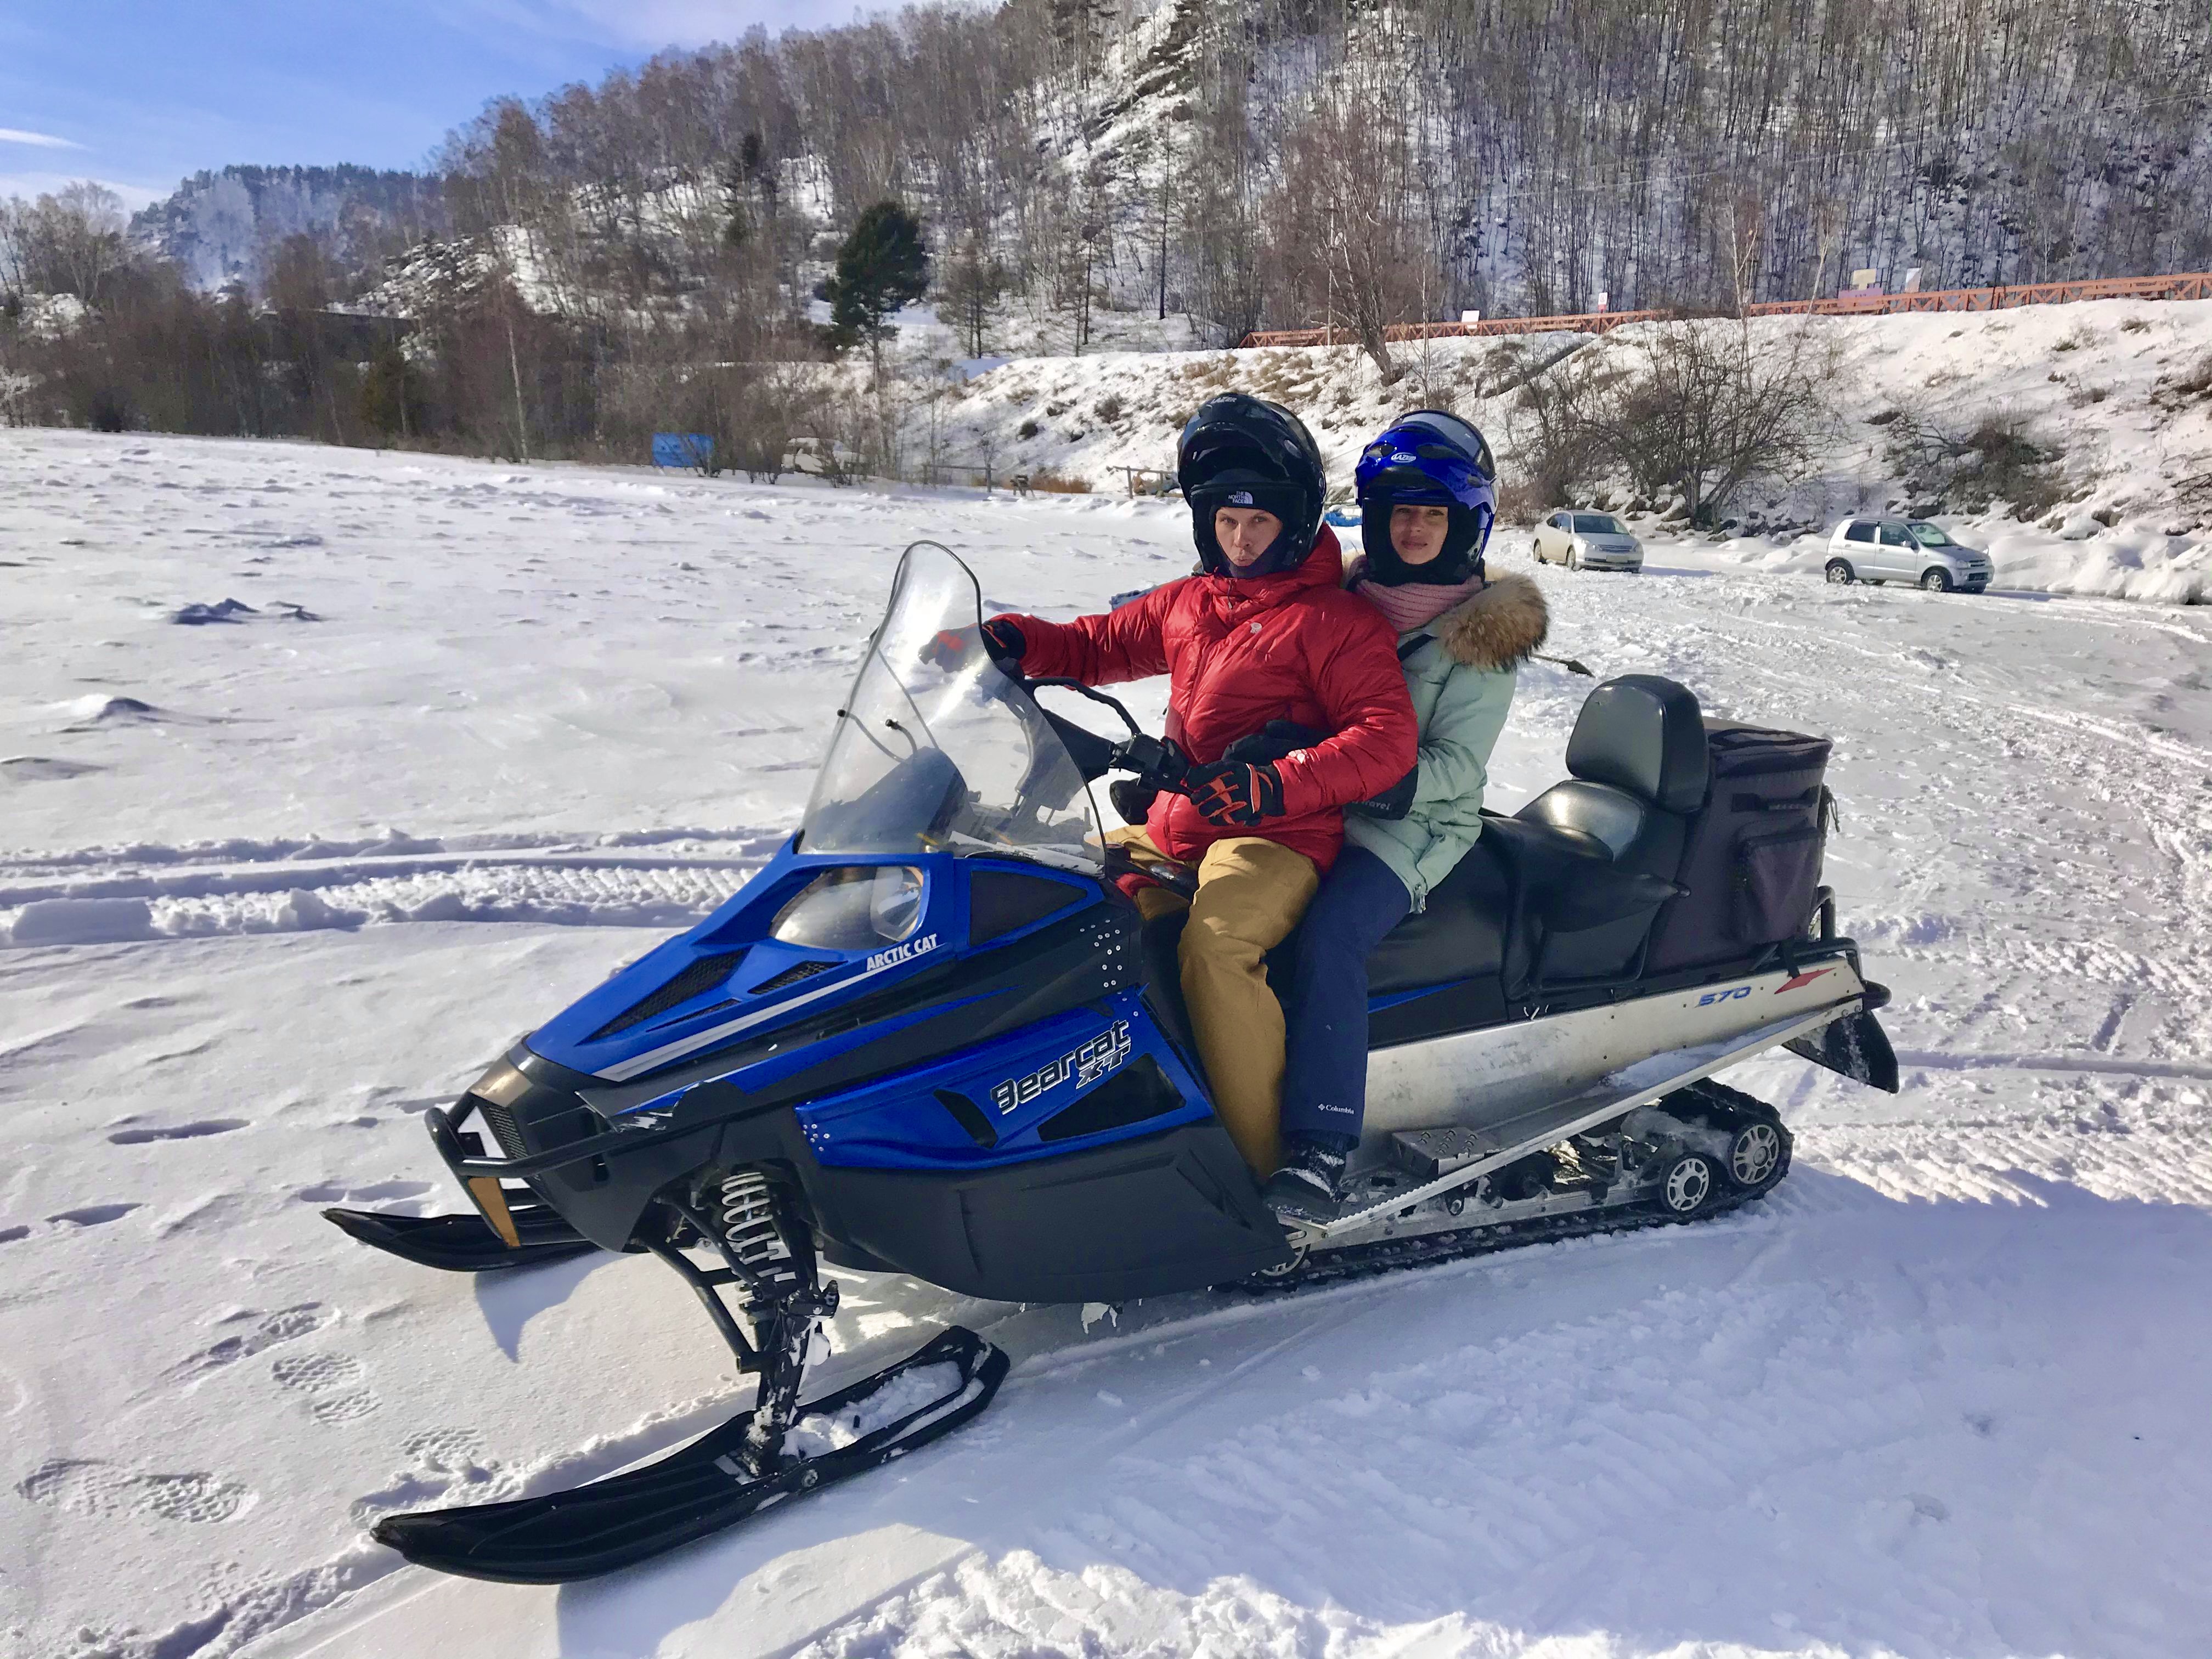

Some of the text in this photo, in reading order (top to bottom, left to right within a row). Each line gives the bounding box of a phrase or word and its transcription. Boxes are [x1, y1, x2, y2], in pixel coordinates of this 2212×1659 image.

[866, 933, 937, 972] ARCTIC CAT
[1697, 985, 1752, 1007] 570
[990, 1019, 1131, 1115] Bearcat
[1076, 1042, 1131, 1090] XT
[1325, 1104, 1355, 1115] Columbia
